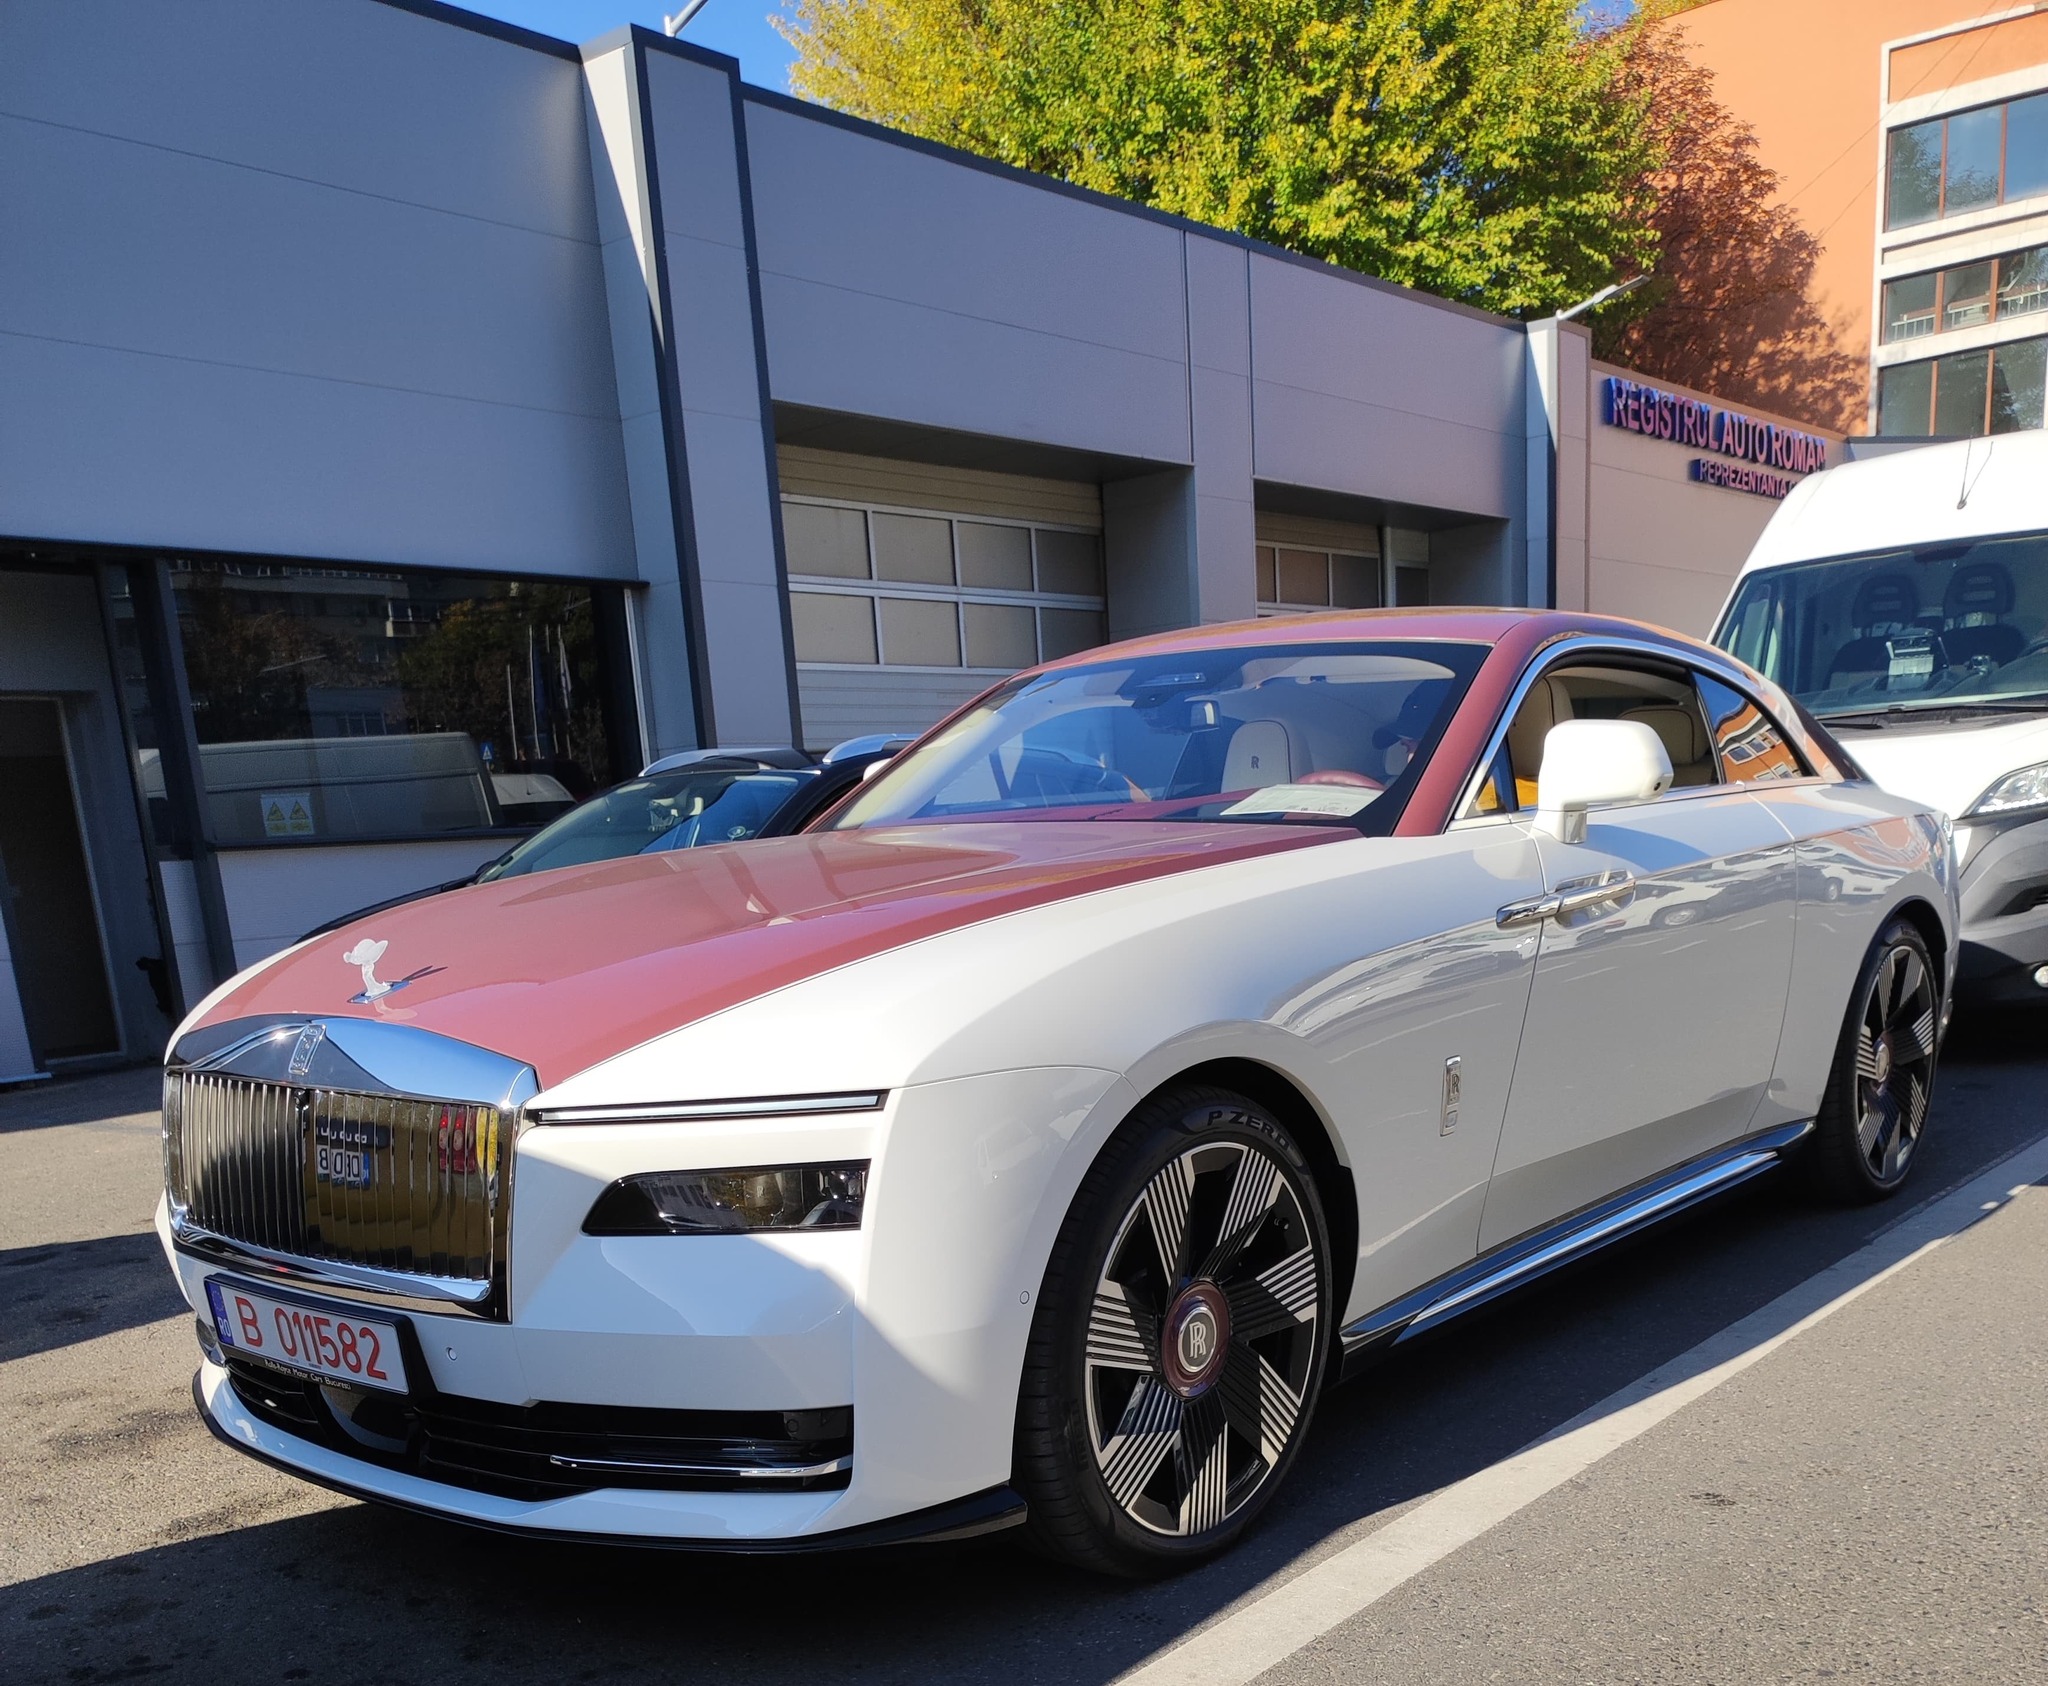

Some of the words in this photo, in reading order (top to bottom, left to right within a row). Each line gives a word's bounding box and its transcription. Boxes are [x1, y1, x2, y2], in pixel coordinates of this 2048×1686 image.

[1607, 377, 1719, 450] REGISTRUL
[1720, 411, 1767, 464] AUTO
[1207, 1110, 1223, 1126] P
[1229, 1110, 1290, 1151] ZERO
[217, 1316, 232, 1338] RO
[234, 1296, 263, 1348] B
[273, 1307, 388, 1381] 011582
